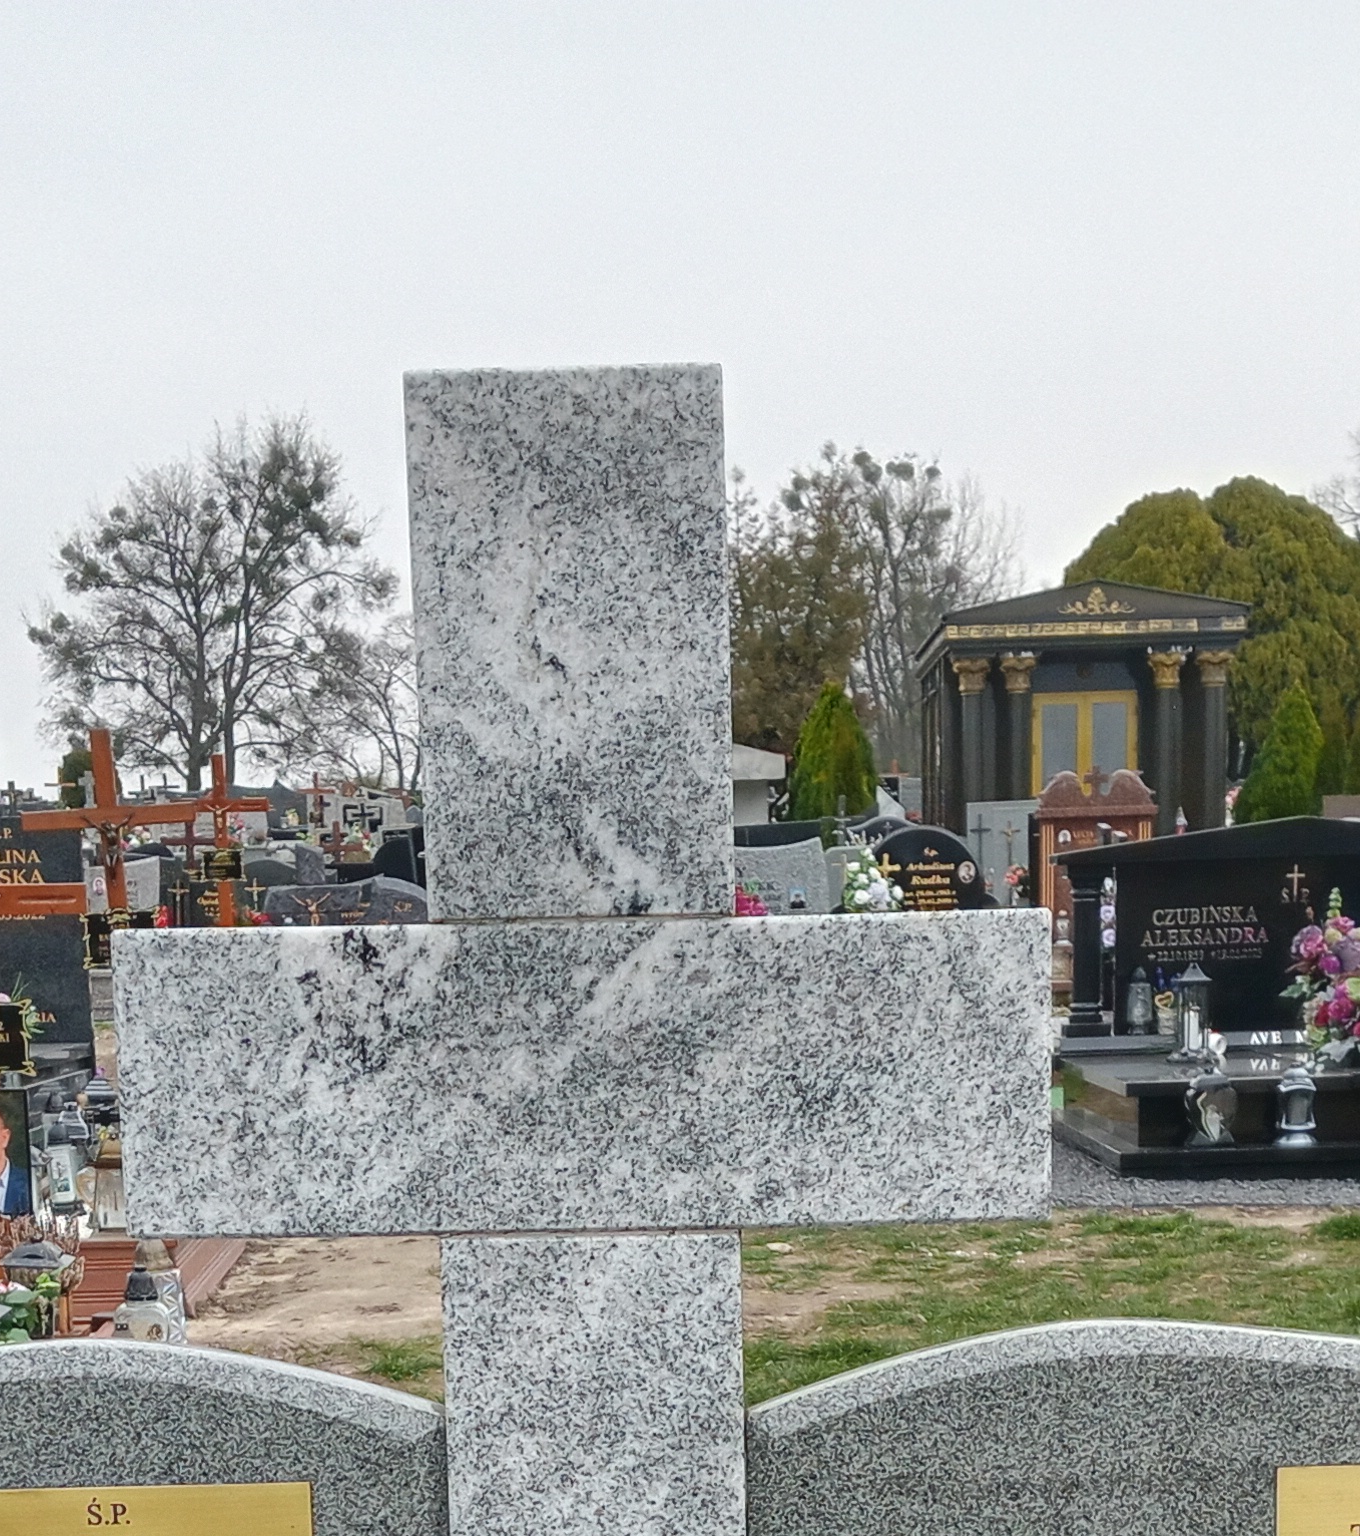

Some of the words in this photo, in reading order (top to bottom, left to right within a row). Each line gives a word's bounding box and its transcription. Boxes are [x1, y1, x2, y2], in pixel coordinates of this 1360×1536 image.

[1152, 904, 1259, 926] CZUBIŃSKA
[1140, 926, 1269, 948] ALEKSANDRA
[87, 1497, 131, 1526] Ś.P.
